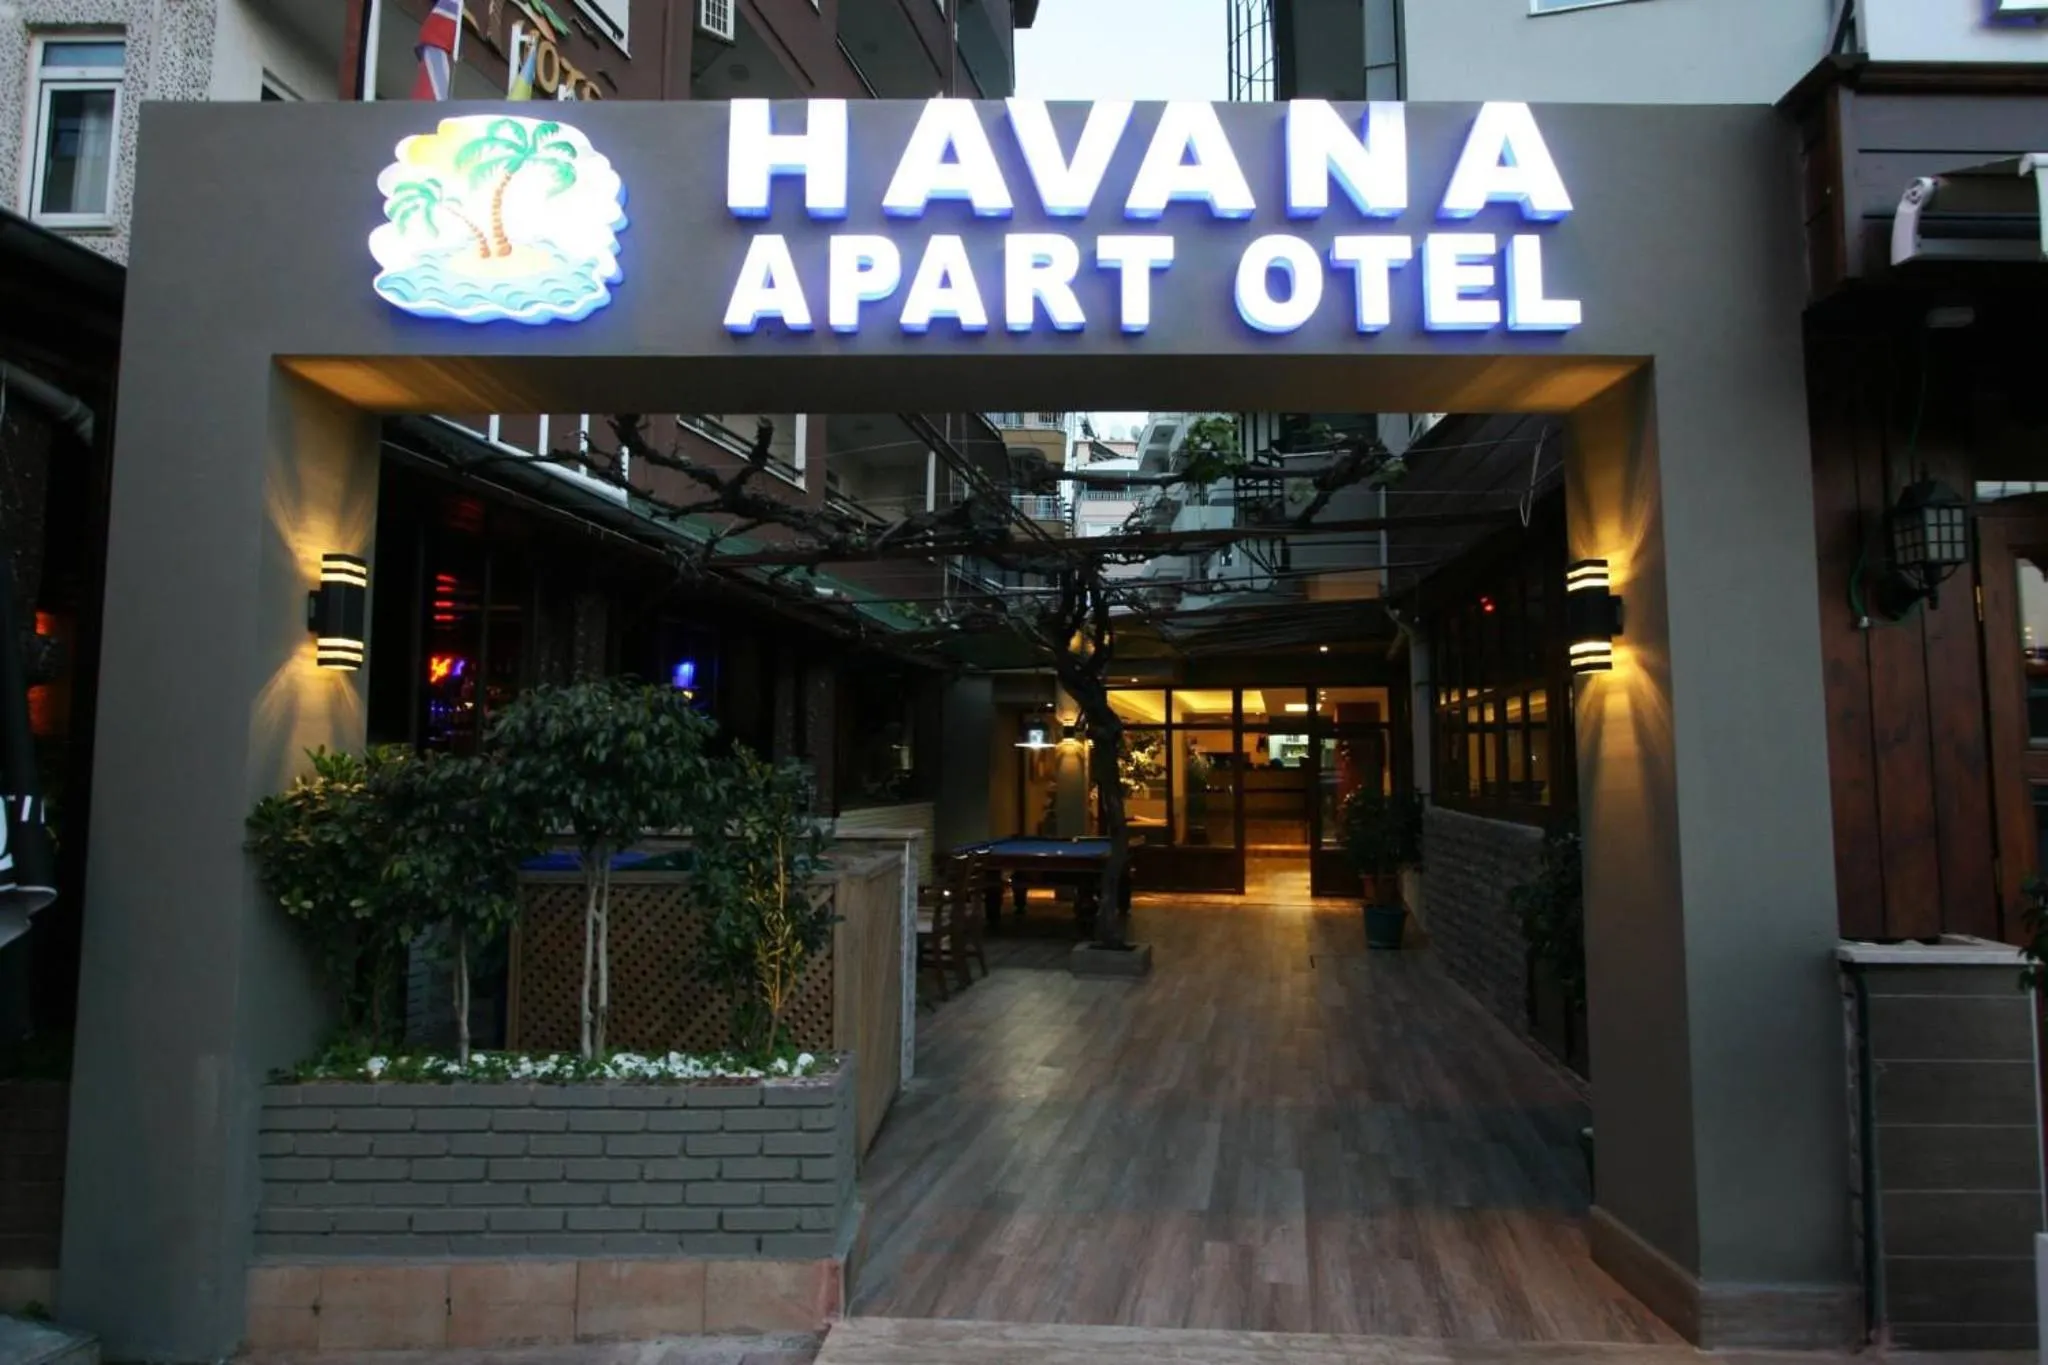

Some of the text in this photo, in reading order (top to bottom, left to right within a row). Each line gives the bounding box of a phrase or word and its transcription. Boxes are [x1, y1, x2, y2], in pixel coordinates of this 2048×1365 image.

[727, 97, 1574, 219] HAVANA
[723, 233, 1582, 332] APART OTEL
